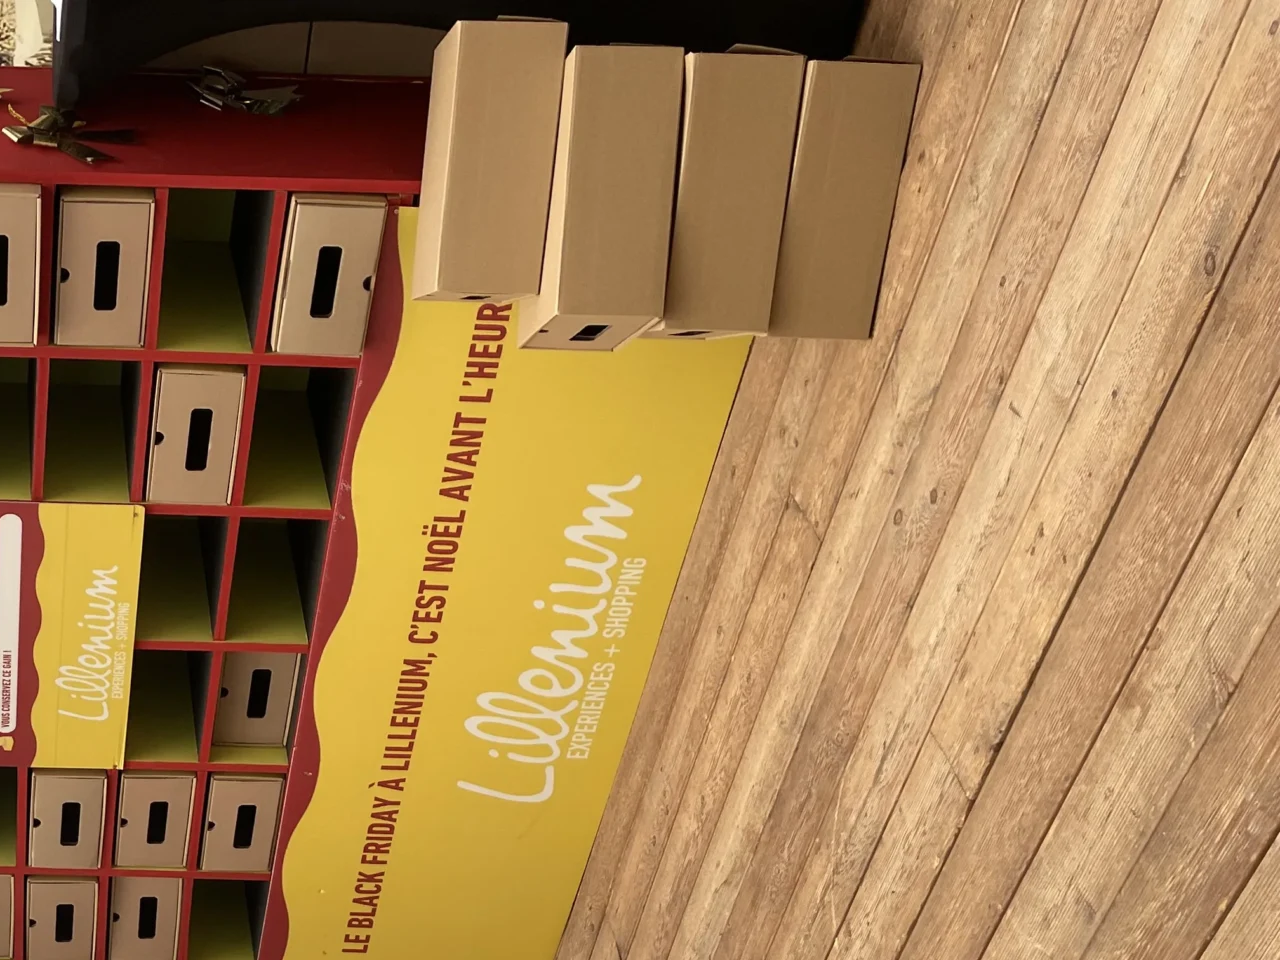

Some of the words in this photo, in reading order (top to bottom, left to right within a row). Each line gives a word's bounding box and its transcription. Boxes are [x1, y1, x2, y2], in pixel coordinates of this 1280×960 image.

[458, 303, 512, 403] L'HEUR
[439, 412, 487, 502] AVANT
[421, 510, 466, 572] NOËL
[55, 565, 118, 720] Lillenium
[116, 603, 130, 640] SHOPPING
[408, 580, 449, 644] C'EST
[457, 475, 642, 802] Lillenium
[3, 655, 11, 668] GAIN
[111, 652, 126, 698] EXPERIENCES
[566, 662, 616, 759] EXPERIENCES
[602, 557, 647, 638] SHOPPING
[1, 713, 10, 728] VOUS
[2, 679, 11, 711] CONSERVEZ
[380, 652, 438, 770] LILLENIUM,
[369, 778, 406, 791] À
[360, 796, 402, 865] FRIDAY
[347, 871, 385, 928] BLACK
[341, 934, 371, 954] LE
